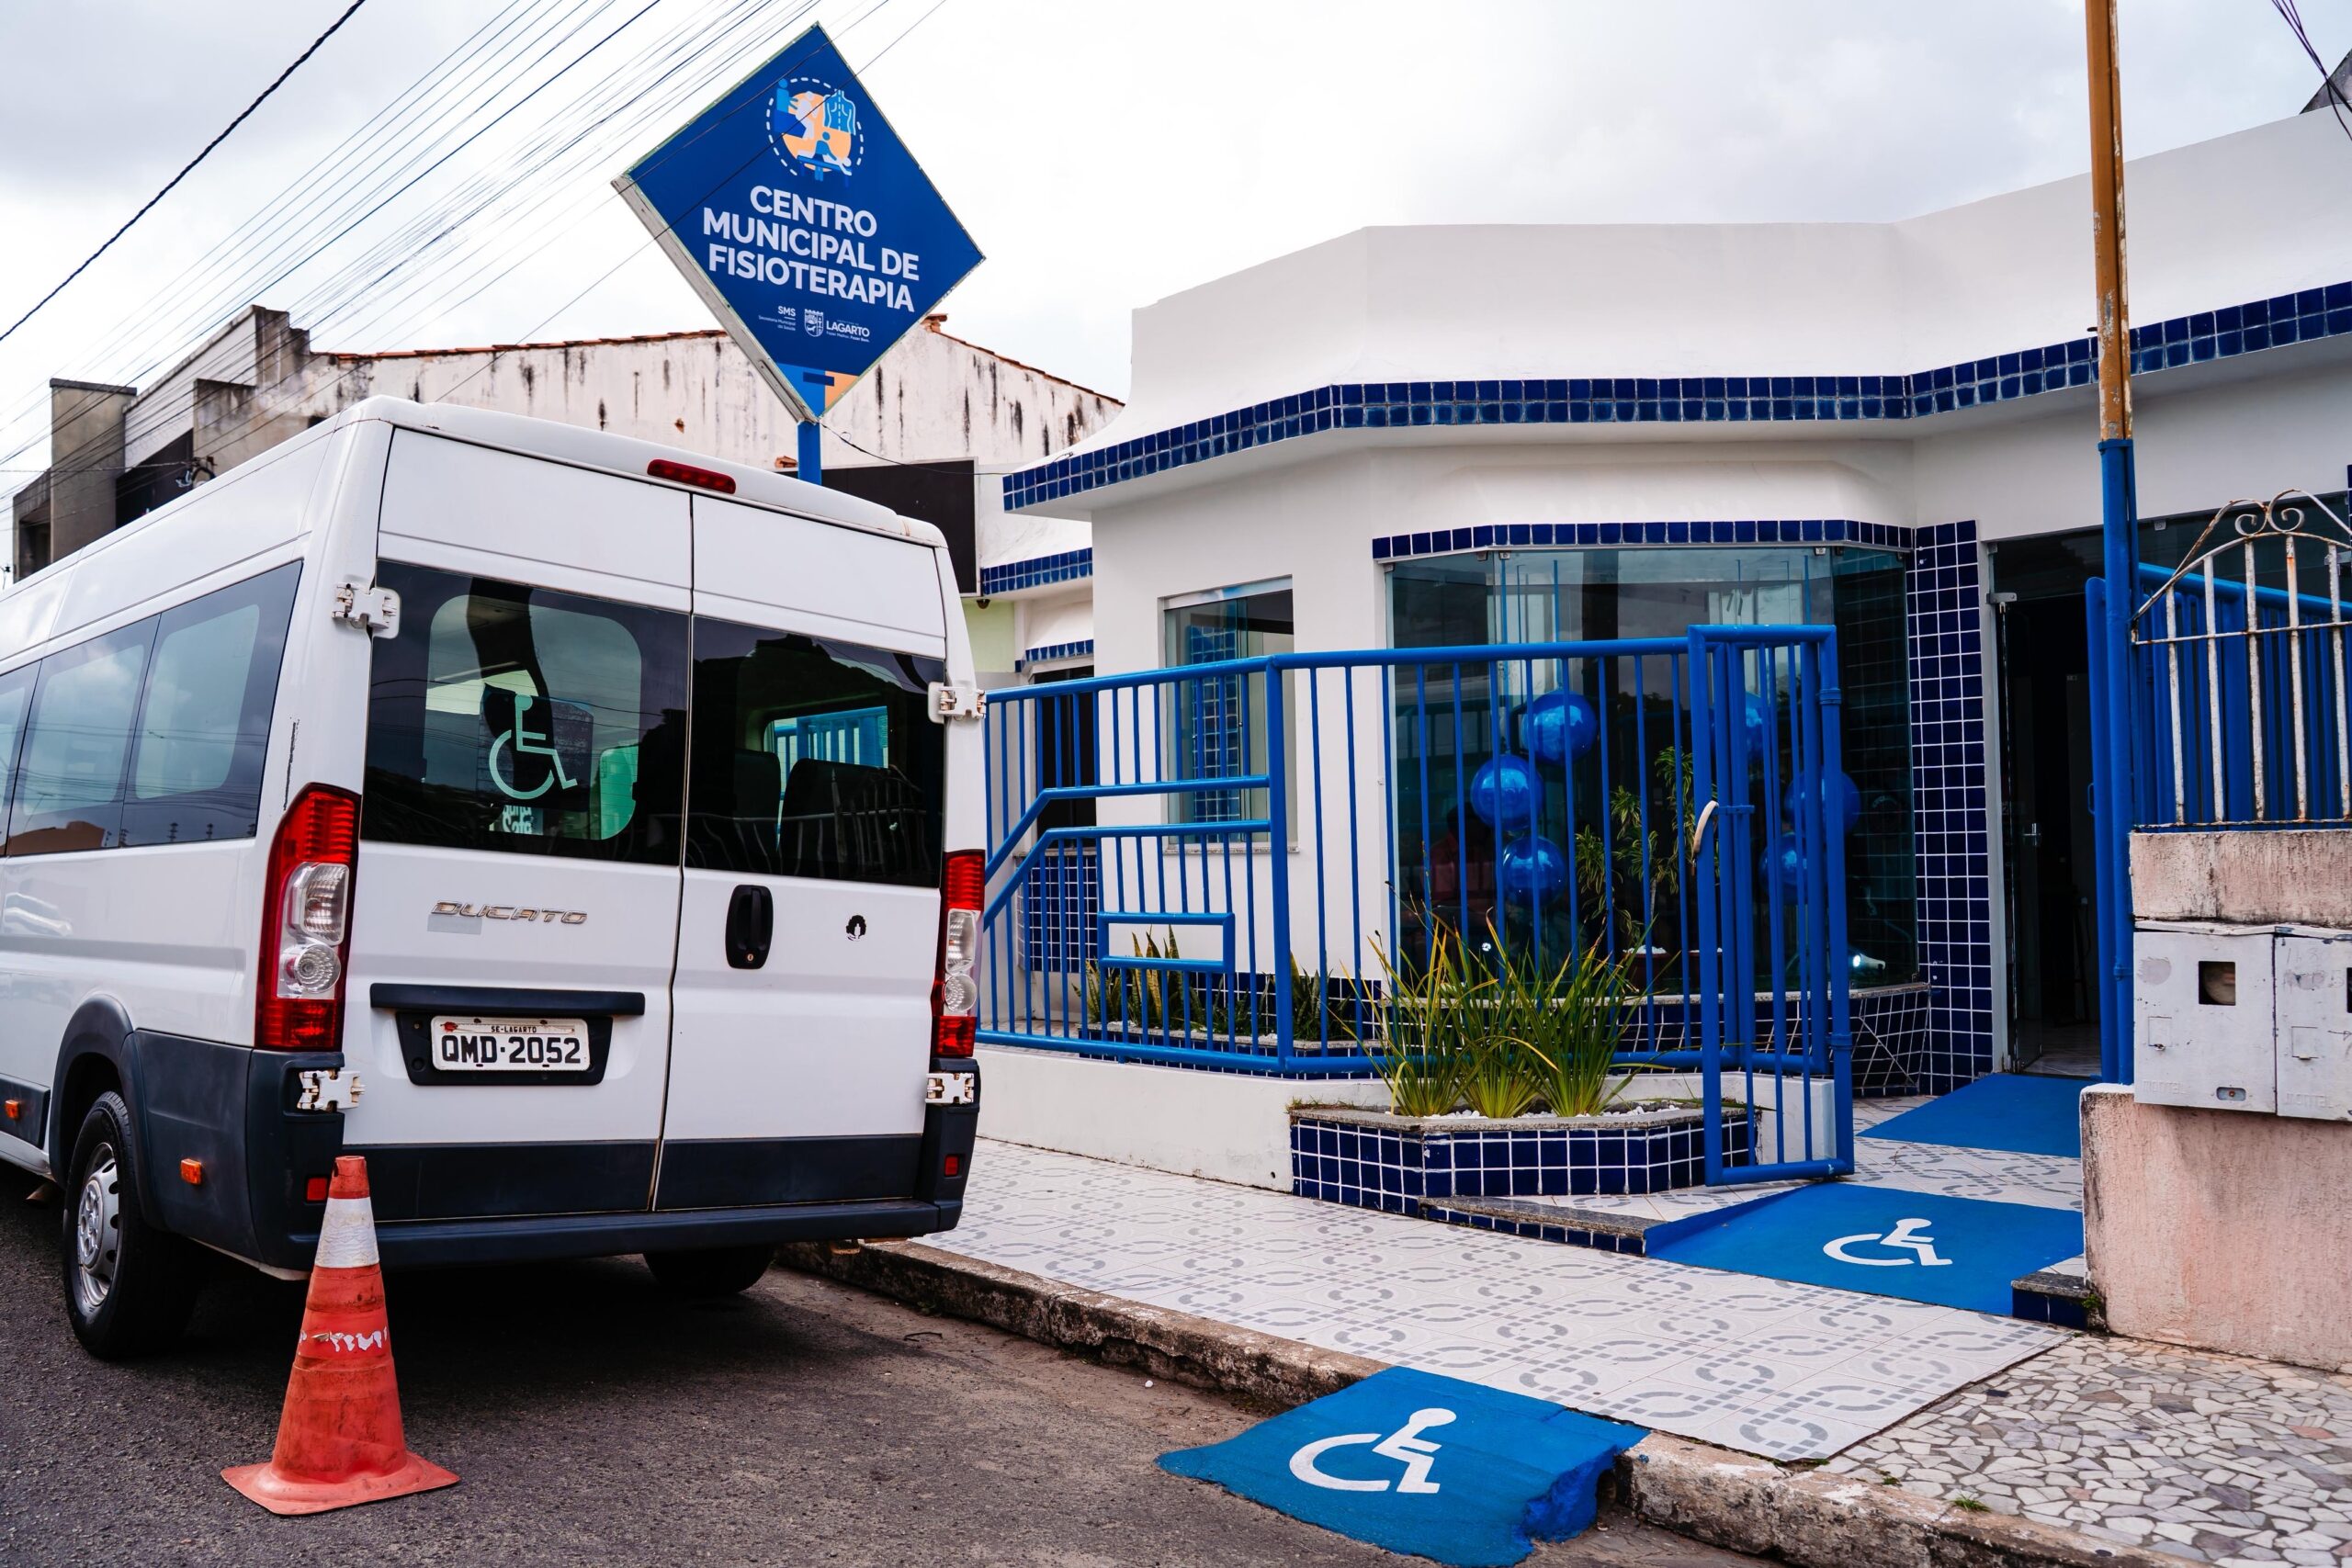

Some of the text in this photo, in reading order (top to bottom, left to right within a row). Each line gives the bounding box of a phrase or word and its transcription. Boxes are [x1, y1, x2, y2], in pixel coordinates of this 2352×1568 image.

[750, 186, 876, 237] CENTRO
[703, 207, 919, 281] MUNICIPAL DE
[707, 243, 915, 312] FISIOTERAPIA
[778, 306, 796, 317] SMS
[826, 321, 870, 337] LAGARTO
[430, 899, 588, 925] DUCATO
[491, 1024, 537, 1033] SE-LAGARTO
